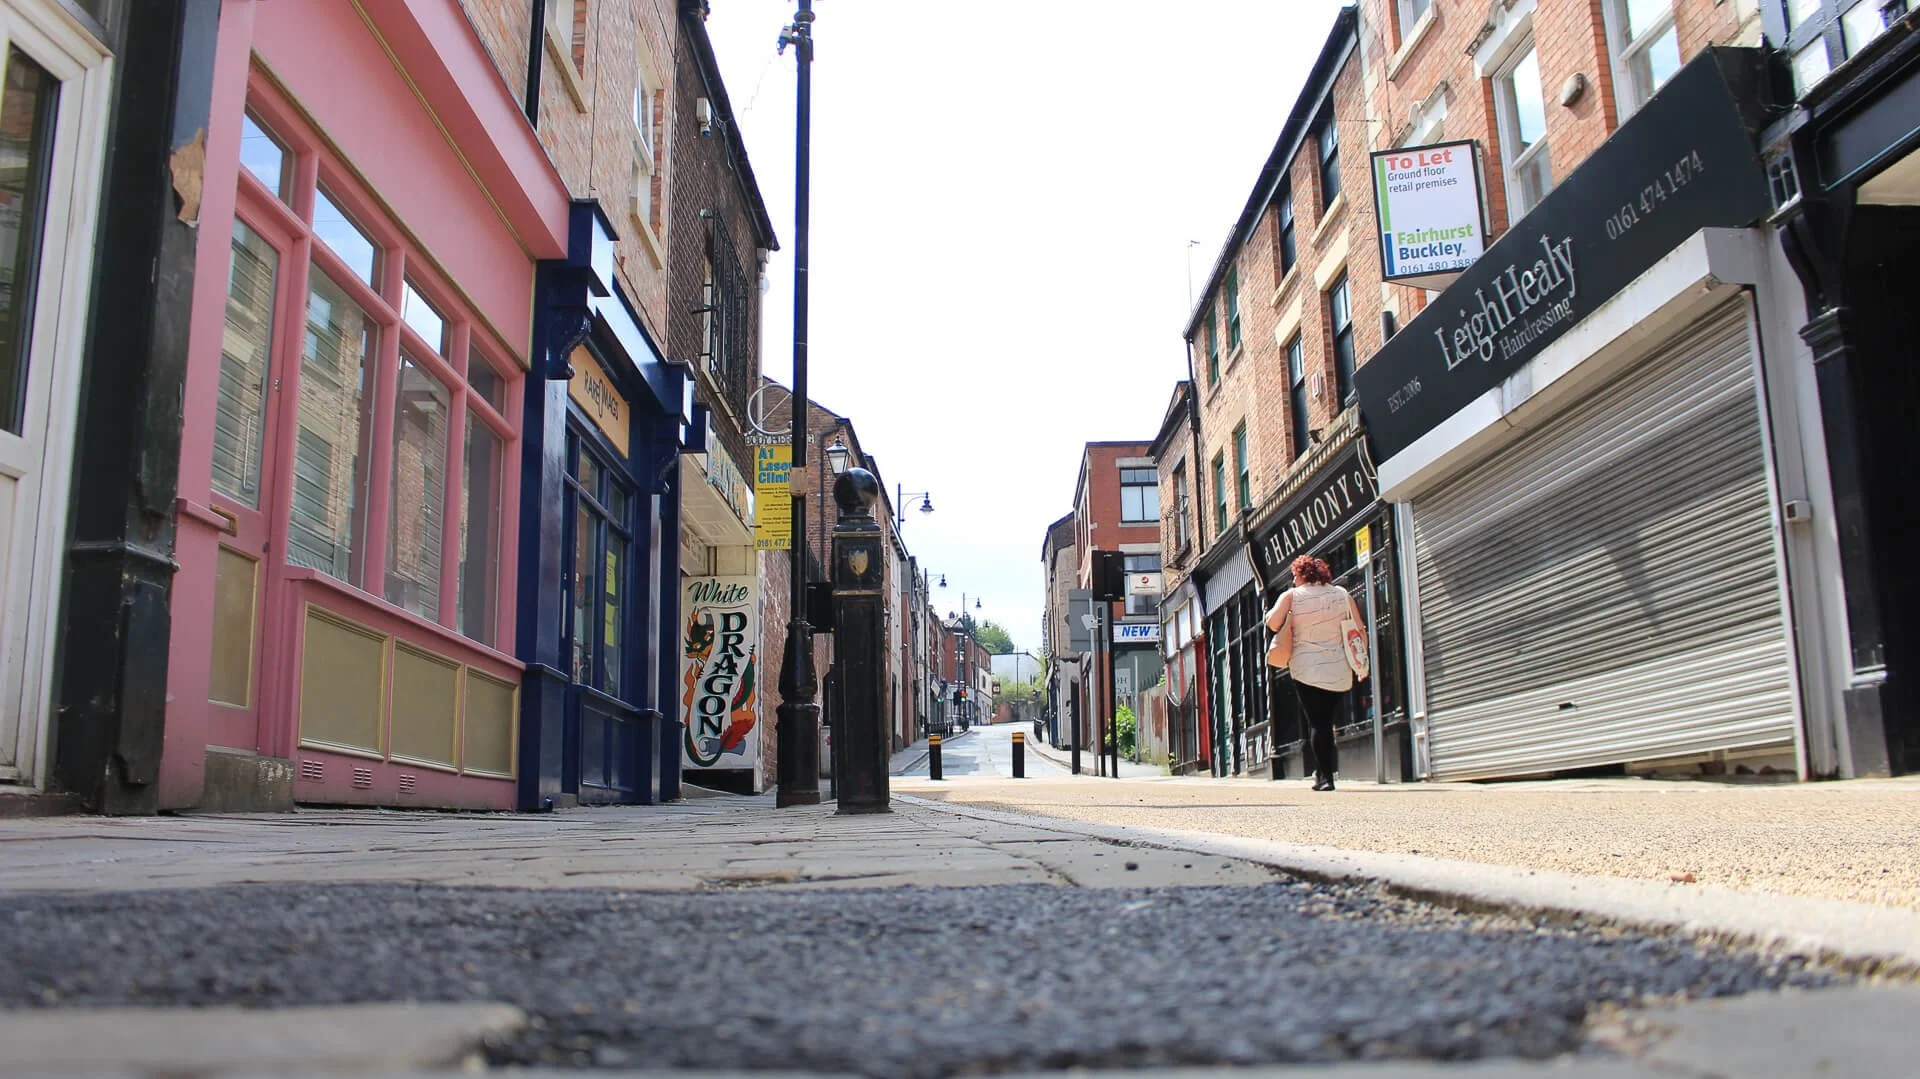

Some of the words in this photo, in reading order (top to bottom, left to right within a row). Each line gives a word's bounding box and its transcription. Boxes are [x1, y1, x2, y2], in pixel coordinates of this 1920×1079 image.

[1386, 157, 1413, 171] To
[1418, 149, 1453, 167] Let
[1387, 169, 1422, 182] Ground
[1424, 166, 1446, 178] floor
[1389, 181, 1413, 193] retail
[1416, 176, 1458, 191] premises
[1606, 202, 1641, 240] 0161
[1640, 179, 1667, 214] 474
[1665, 149, 1704, 193] 1474
[1397, 223, 1474, 245] Fairhurst
[1400, 263, 1424, 274] 0161
[1428, 260, 1449, 271] 480
[1499, 297, 1574, 360] Hairdressing
[758, 472, 790, 483] Clini
[1270, 474, 1352, 564] HARMONY
[687, 578, 749, 604] White
[1121, 625, 1151, 637] NEW
[698, 611, 747, 736] DRAGON
